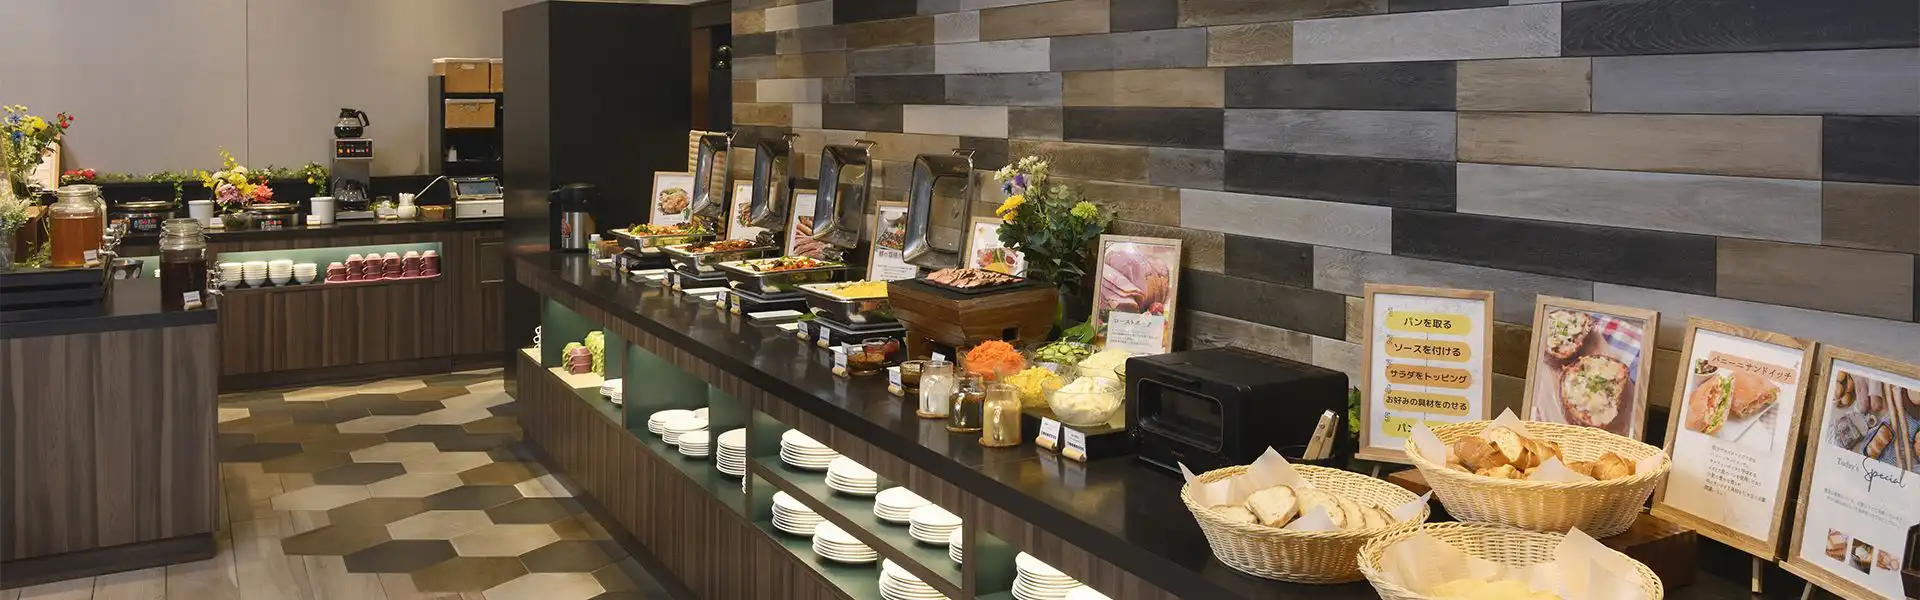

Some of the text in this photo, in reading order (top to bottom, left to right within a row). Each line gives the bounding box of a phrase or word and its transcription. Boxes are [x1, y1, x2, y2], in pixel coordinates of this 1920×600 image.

[1403, 316, 1452, 330] パンを取る
[1394, 343, 1461, 357] ソースを付ける
[1711, 355, 1792, 381] パニーニサンドイッチ
[1390, 369, 1468, 384] サラダをトッピング
[1385, 395, 1467, 411] お好みの具材をのせる
[1863, 456, 1906, 493] Special
